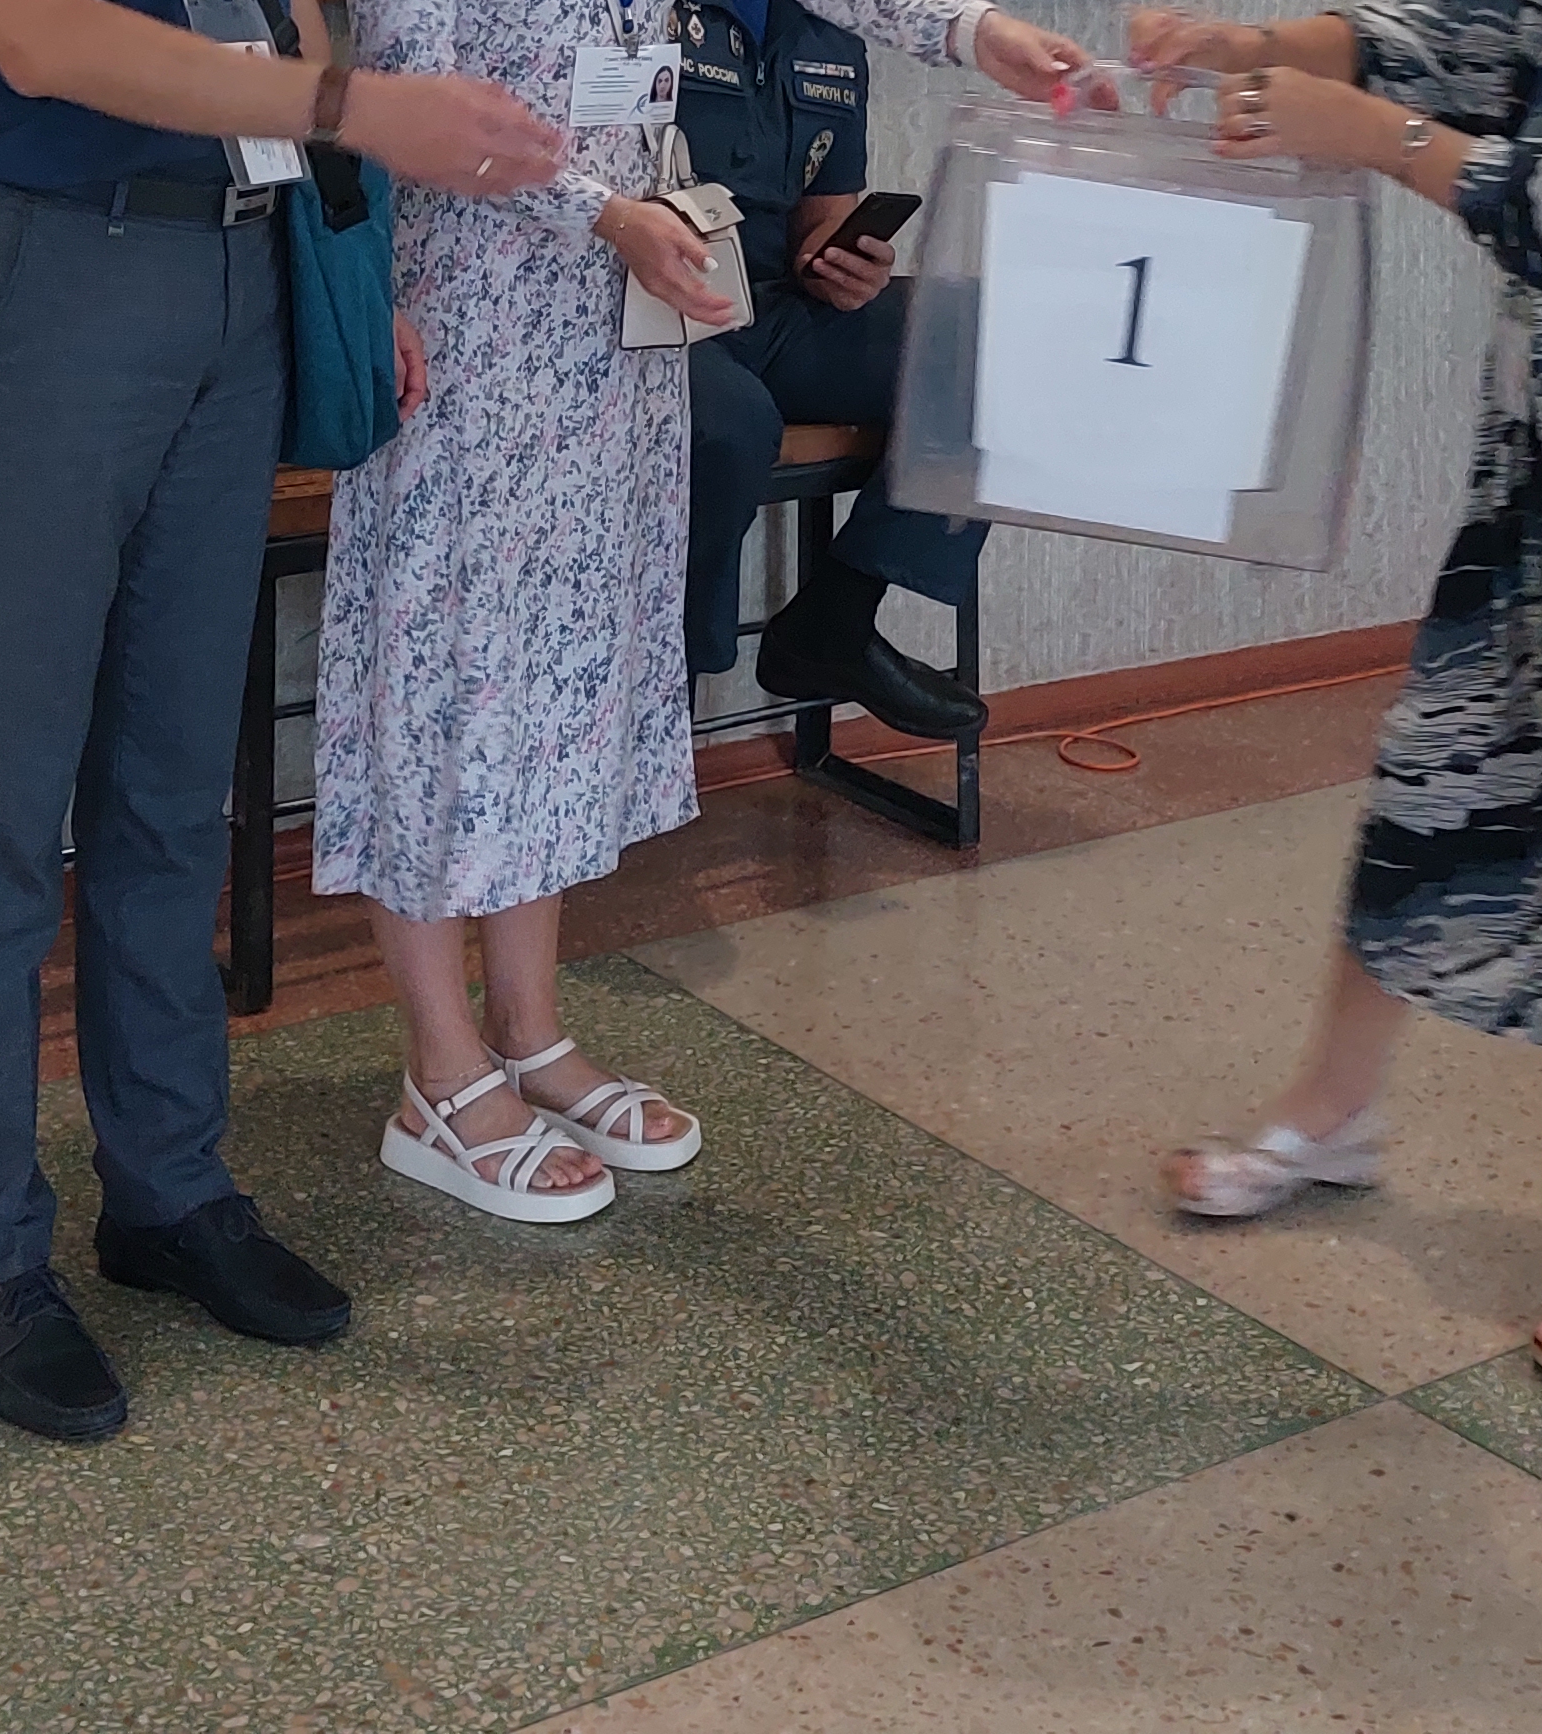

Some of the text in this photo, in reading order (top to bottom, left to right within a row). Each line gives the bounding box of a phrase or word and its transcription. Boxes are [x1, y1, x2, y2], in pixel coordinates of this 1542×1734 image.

[679, 56, 740, 87] ЧС РОССИИ
[802, 81, 842, 103] ПИРКУН
[1103, 256, 1154, 367] 1
